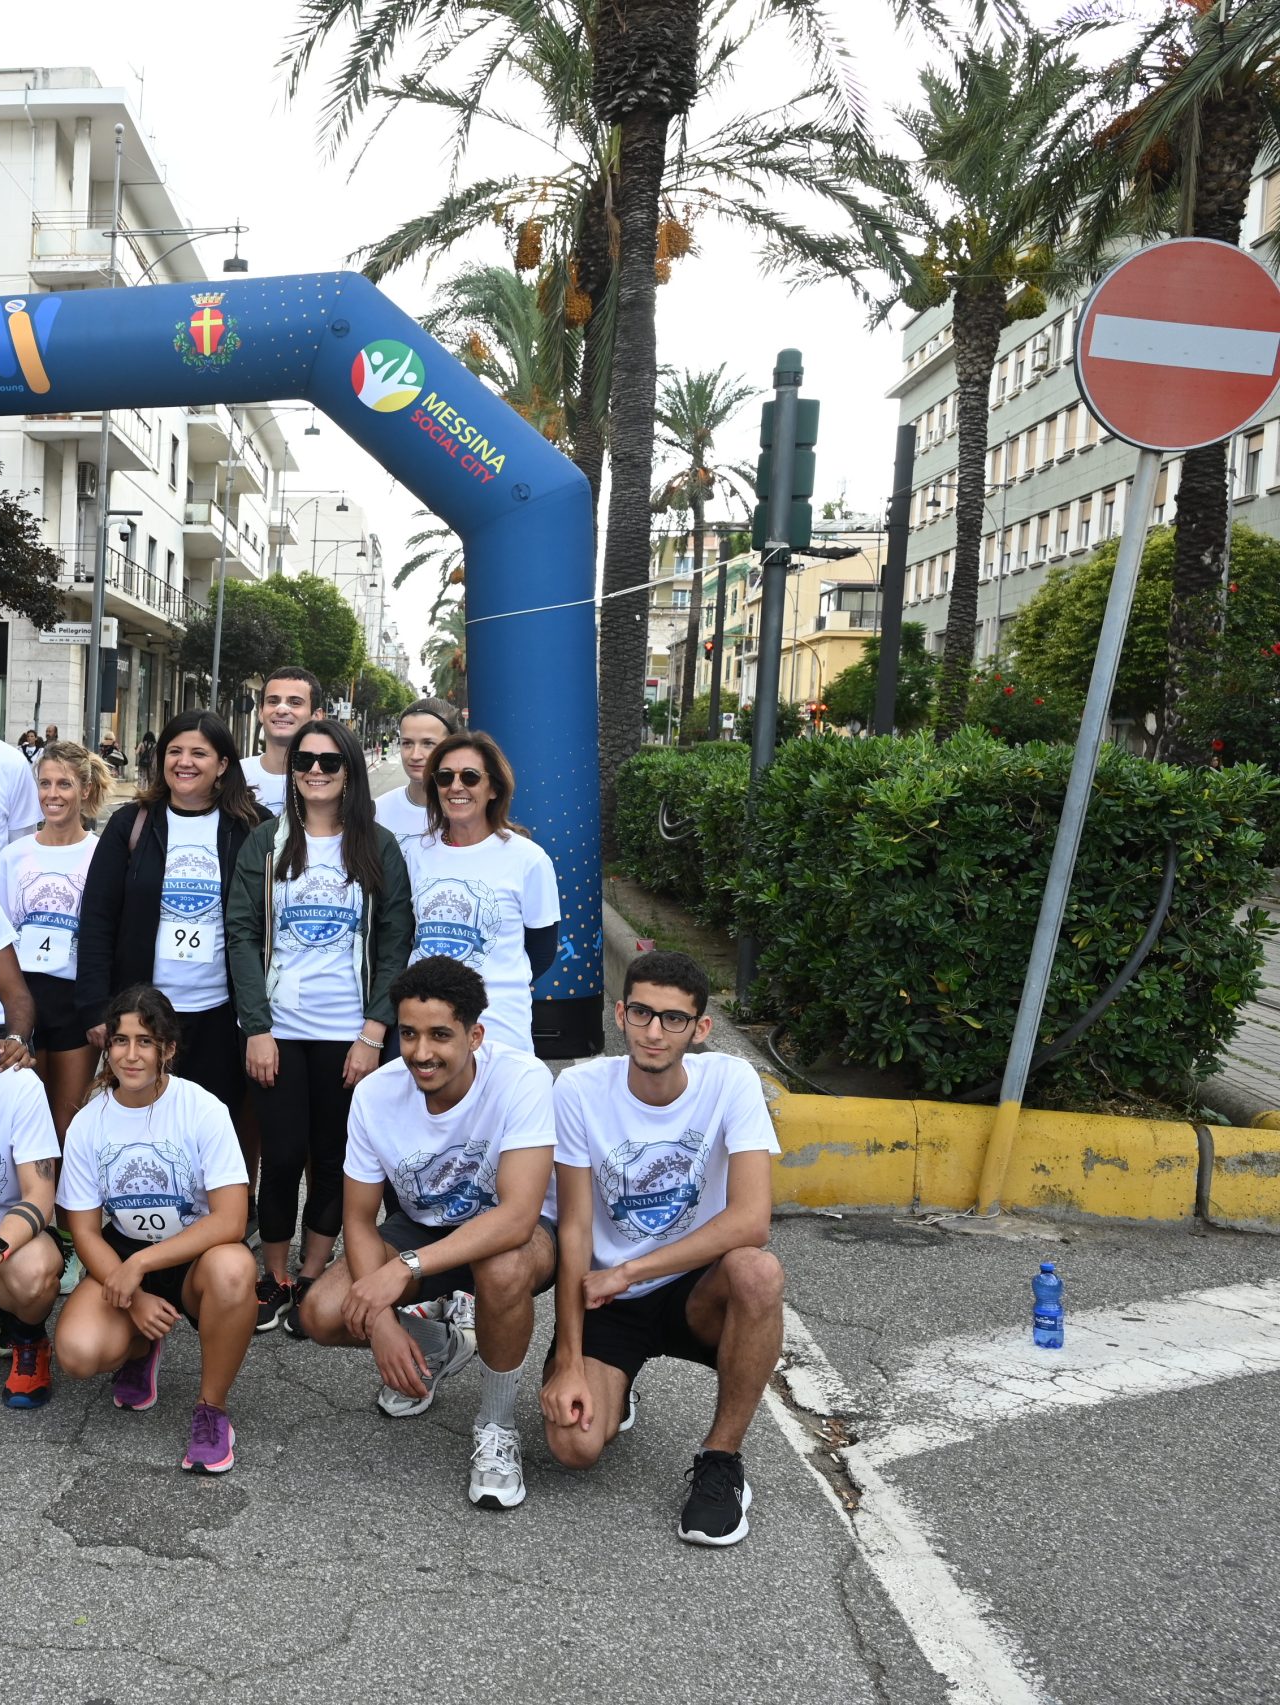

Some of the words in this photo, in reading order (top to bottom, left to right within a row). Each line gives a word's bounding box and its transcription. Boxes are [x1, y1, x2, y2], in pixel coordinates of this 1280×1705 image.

[421, 392, 506, 474] MESSINA
[411, 409, 460, 458] SOCIAL
[460, 454, 495, 484] CITY
[59, 627, 92, 635] Pellegrino
[284, 908, 354, 921] UNIMEGAMES
[39, 935, 51, 952] 4
[174, 929, 201, 948] 96
[108, 1197, 182, 1209] UNIMEGAMES
[132, 1213, 166, 1231] 20
